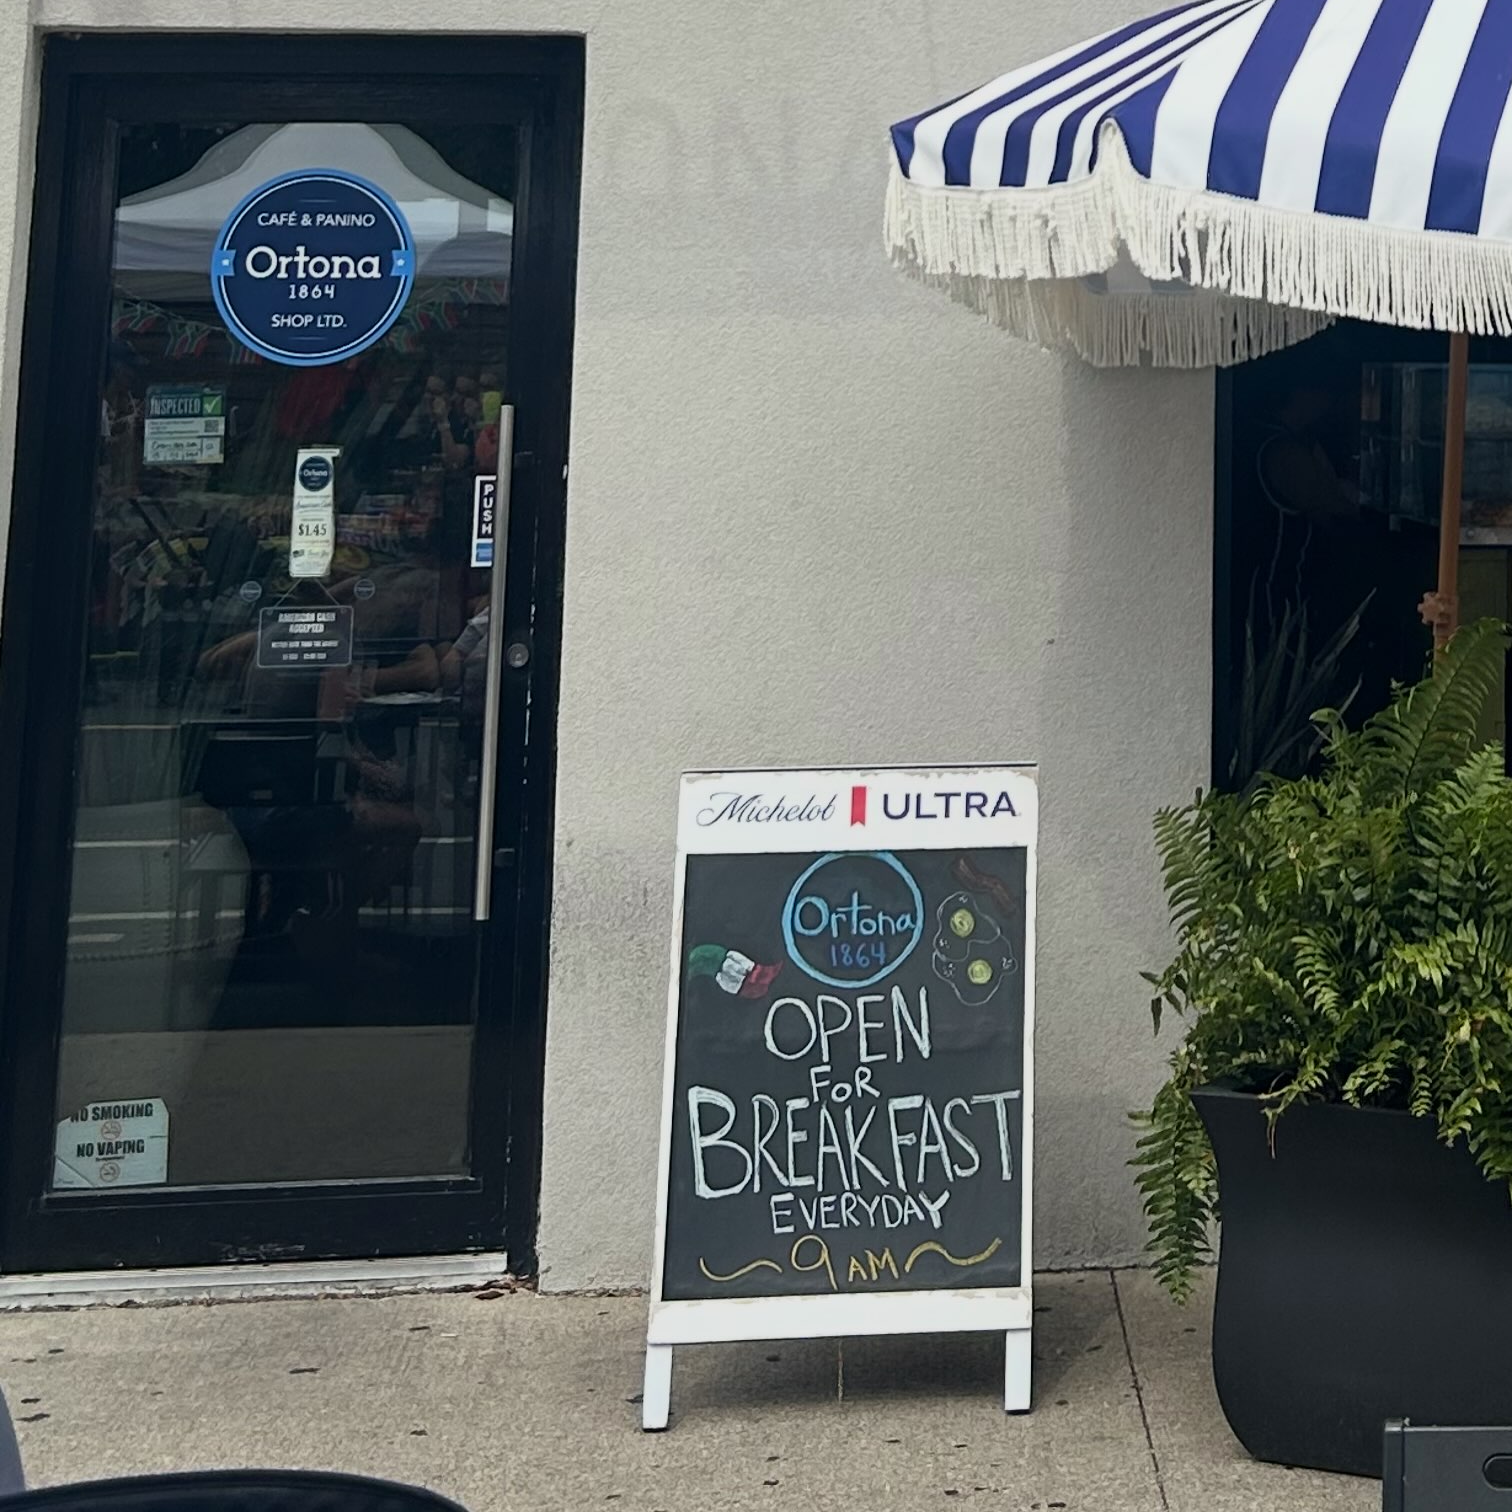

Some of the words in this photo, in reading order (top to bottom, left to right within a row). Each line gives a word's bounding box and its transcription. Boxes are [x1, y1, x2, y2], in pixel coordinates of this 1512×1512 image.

[257, 211, 298, 227] CAFÉ
[301, 213, 312, 227] &
[316, 213, 376, 228] PANINO
[245, 245, 381, 279] Ortona
[289, 284, 335, 299] 1864
[271, 313, 313, 328] SHOP
[317, 314, 347, 328] LTD.
[149, 397, 201, 416] INSPECTED
[481, 484, 494, 534] PUSH
[696, 791, 838, 826] Michelob
[883, 791, 1017, 819] ULTRA
[794, 891, 916, 938] Ortona
[831, 940, 887, 968] 1864
[764, 986, 931, 1063] OPEN
[809, 1065, 880, 1104] FOR
[92, 1103, 153, 1121] SMOKING
[76, 1143, 94, 1157] NO
[97, 1139, 144, 1156] VAPING
[688, 1085, 1021, 1199] BREAKFAST
[770, 1190, 950, 1234] EVERYDAY
[791, 1235, 839, 1290] 9
[848, 1249, 899, 1283] AM
